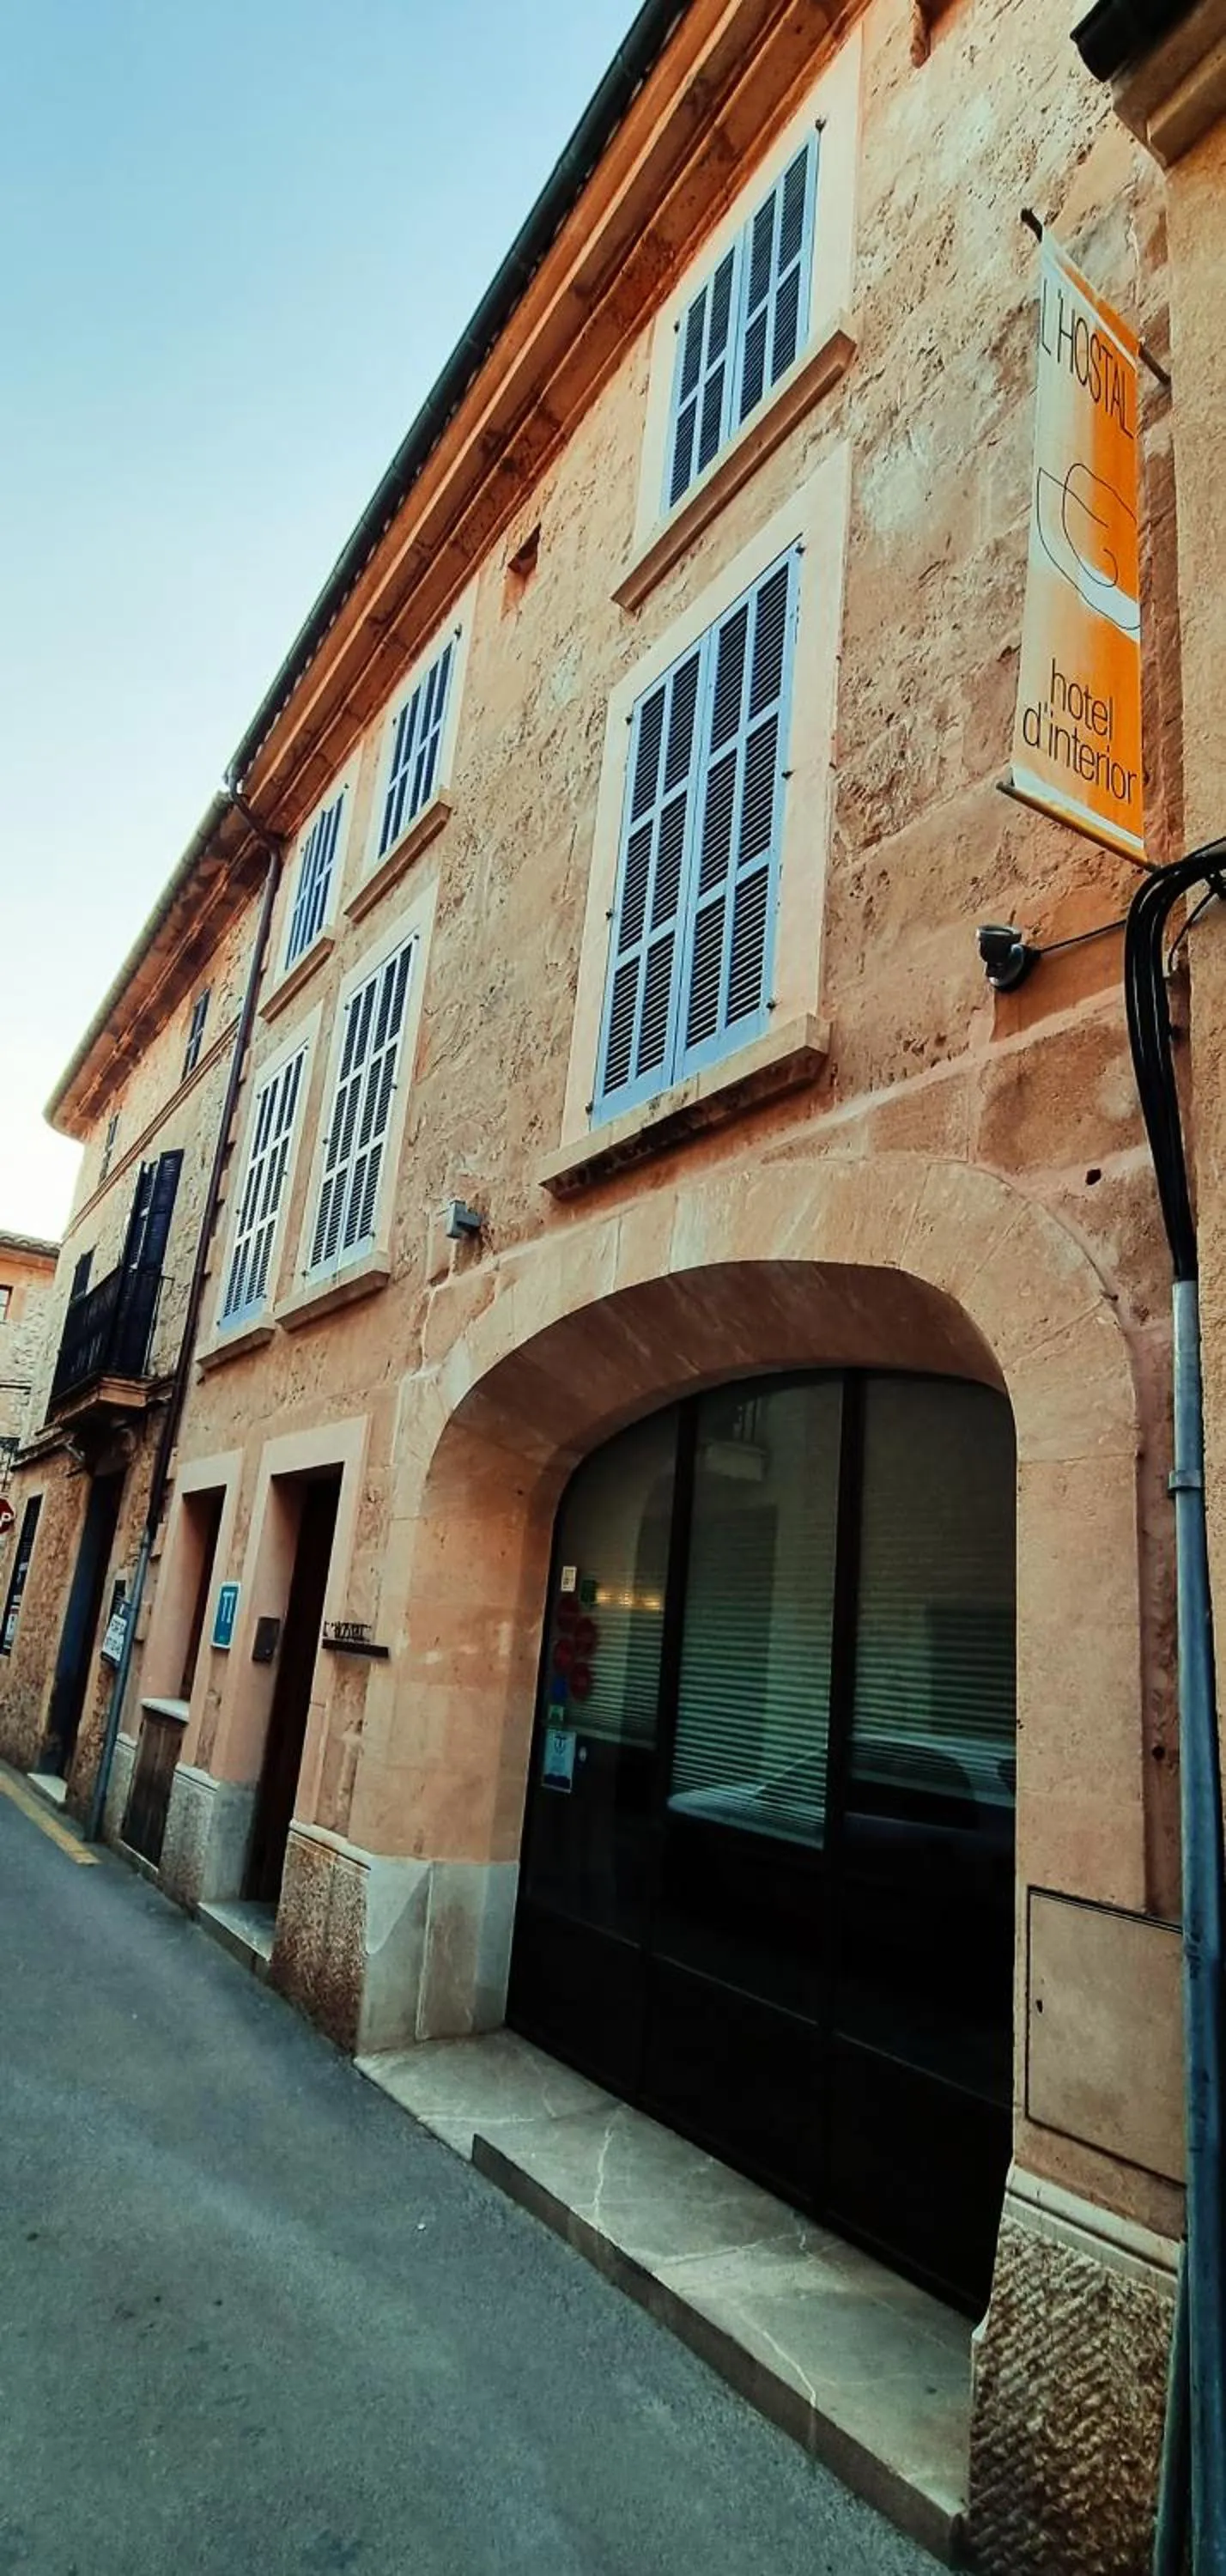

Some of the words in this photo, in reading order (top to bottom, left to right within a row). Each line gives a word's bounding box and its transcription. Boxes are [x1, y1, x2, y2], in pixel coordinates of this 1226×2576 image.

[1041, 277, 1134, 440] L'HOSTAL
[1049, 657, 1114, 741] hotel
[1023, 701, 1138, 805] d'interior
